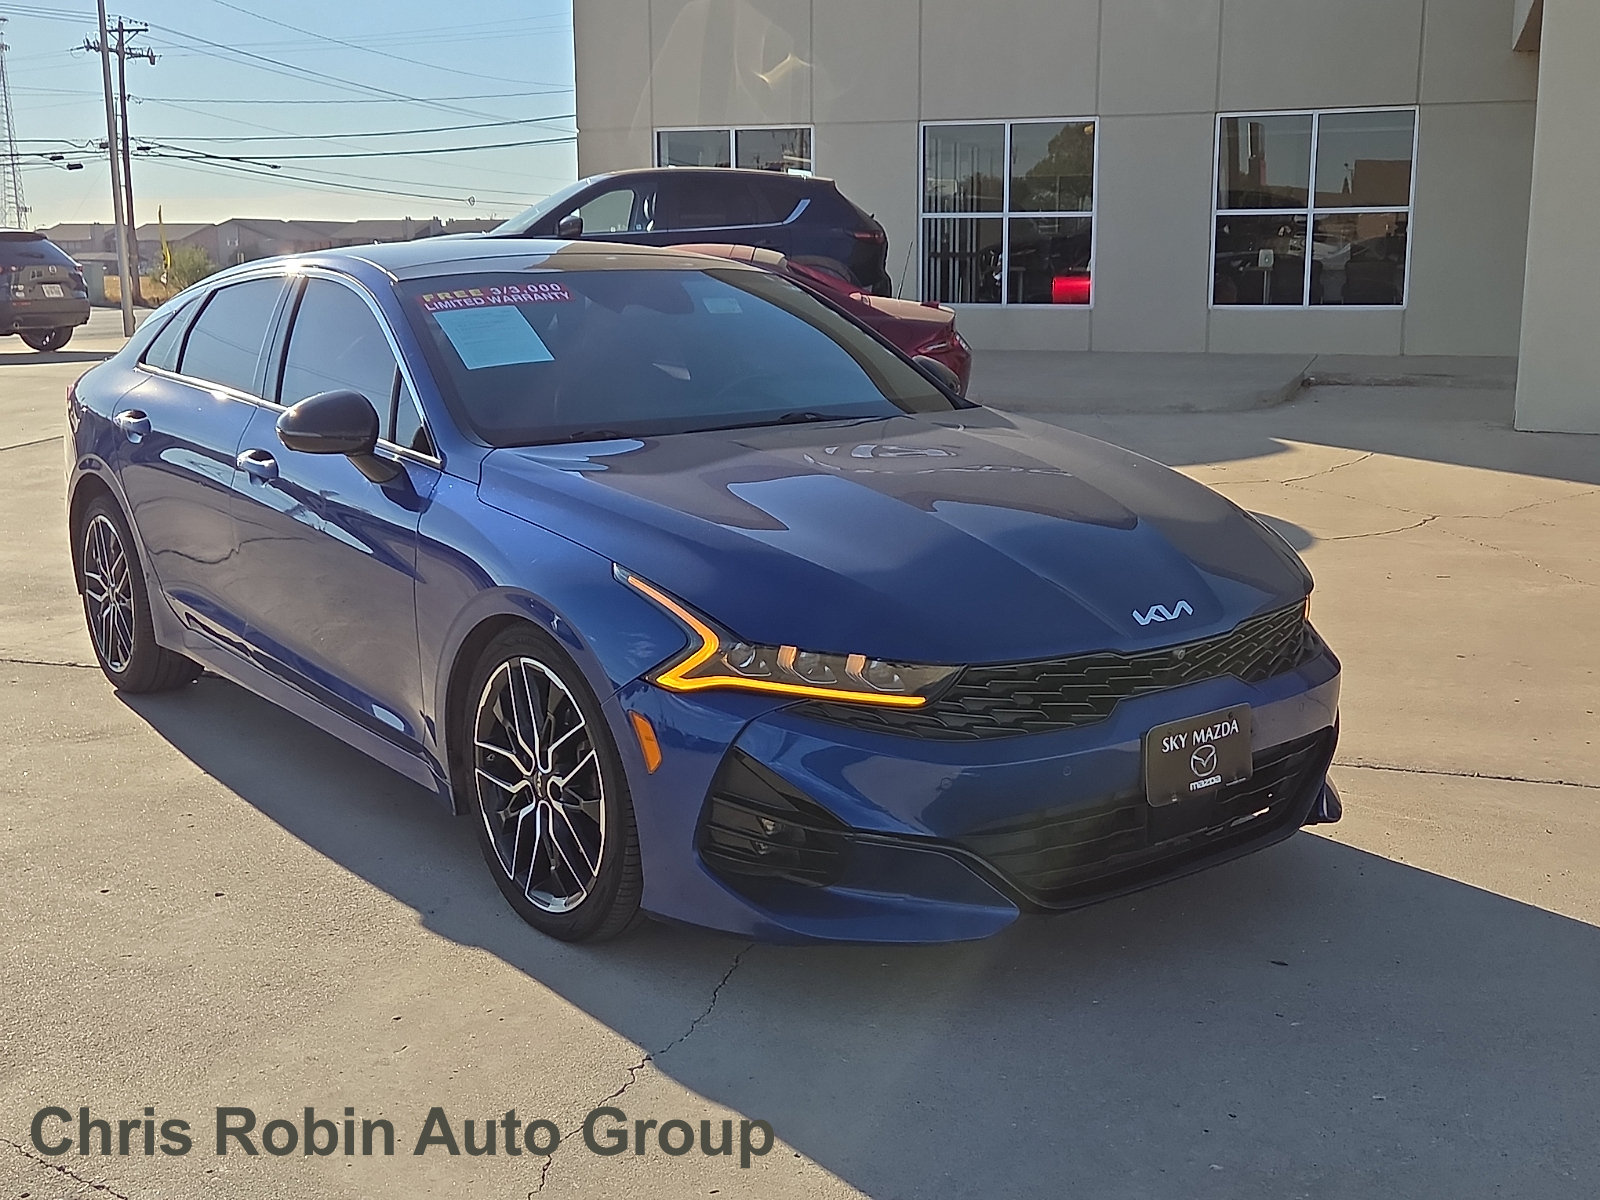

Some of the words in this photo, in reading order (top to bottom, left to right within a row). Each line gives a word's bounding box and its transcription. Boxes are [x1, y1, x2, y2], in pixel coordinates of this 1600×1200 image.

[422, 288, 483, 302] FREE
[424, 297, 485, 311] LIMITED
[486, 291, 570, 304] WARRANTY
[1132, 600, 1193, 626] KIA
[1161, 732, 1188, 753] SKY
[1192, 719, 1239, 745] MAZDA
[1189, 774, 1222, 791] mazda
